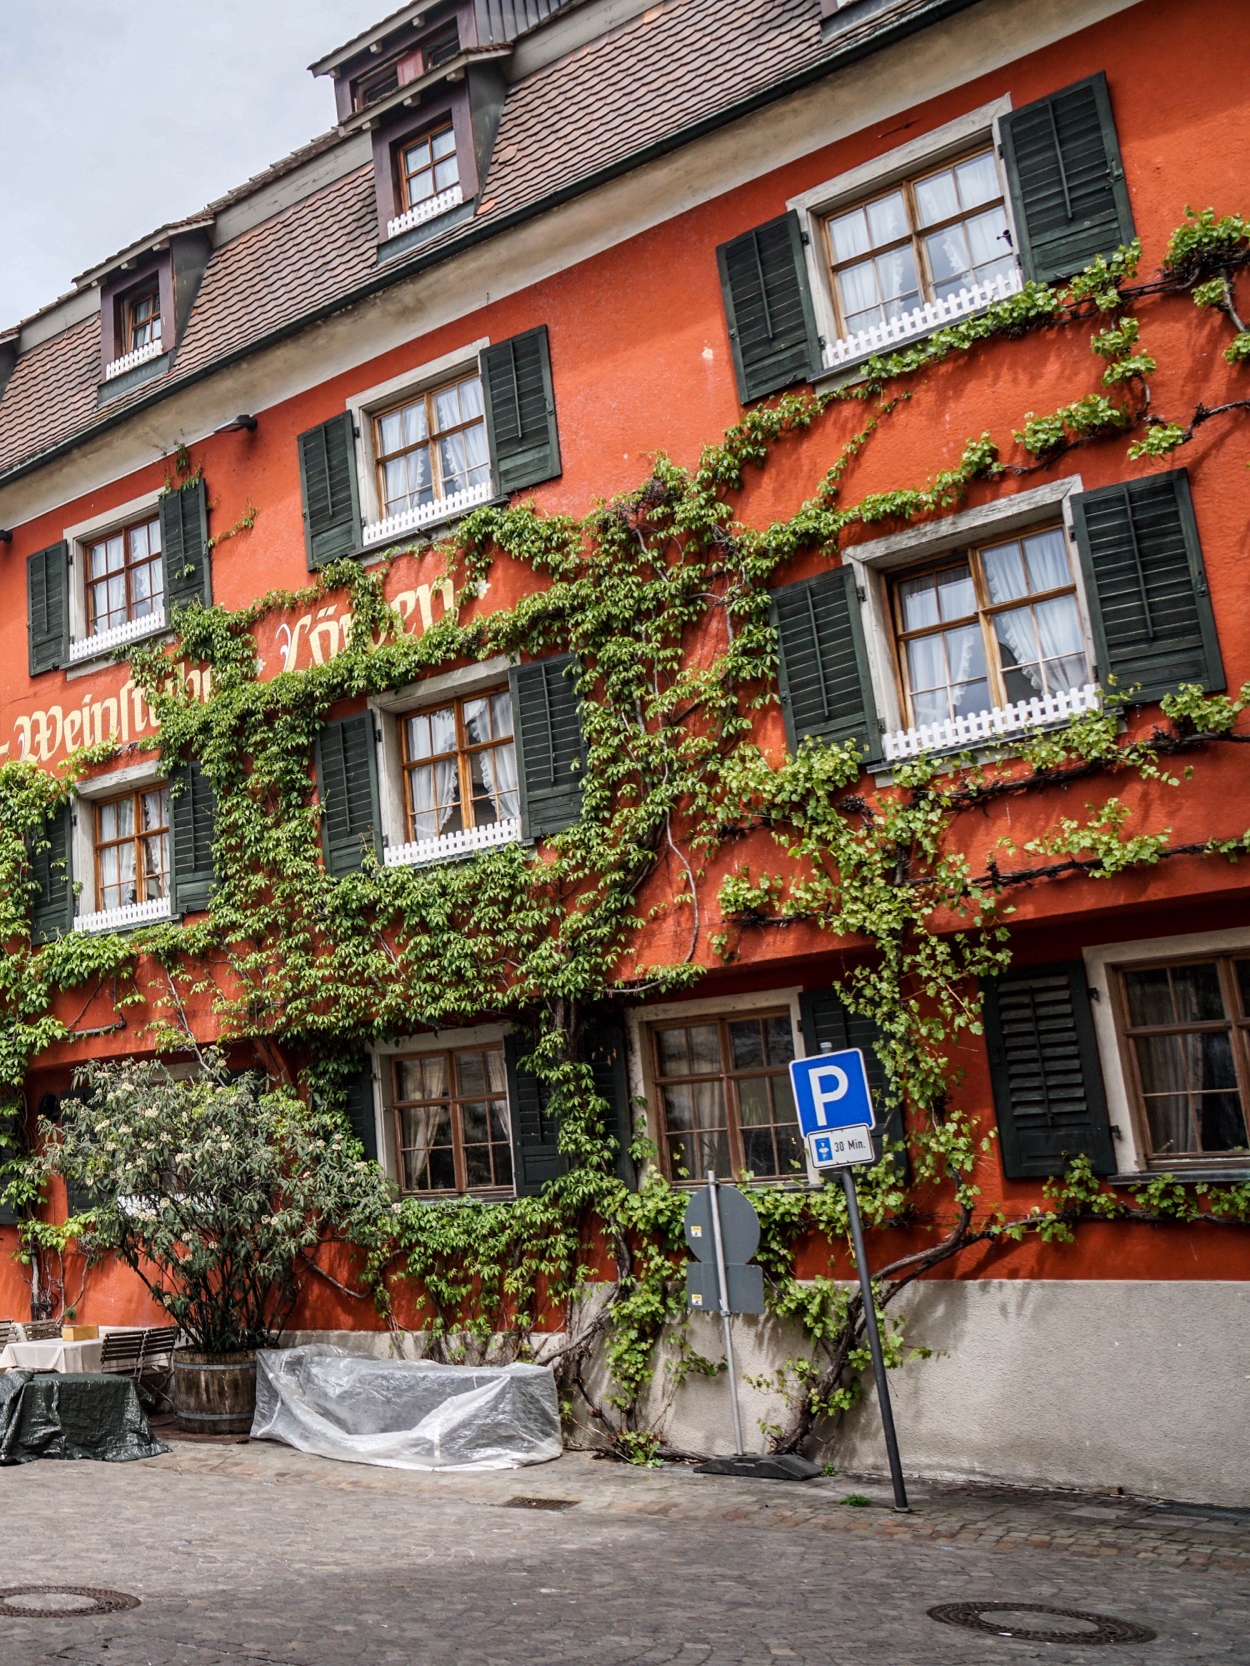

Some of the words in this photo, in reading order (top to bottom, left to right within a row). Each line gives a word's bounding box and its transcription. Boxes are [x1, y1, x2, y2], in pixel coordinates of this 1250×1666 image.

[808, 1065, 849, 1126] P
[834, 1140, 844, 1153] 30
[847, 1138, 866, 1151] Min.
